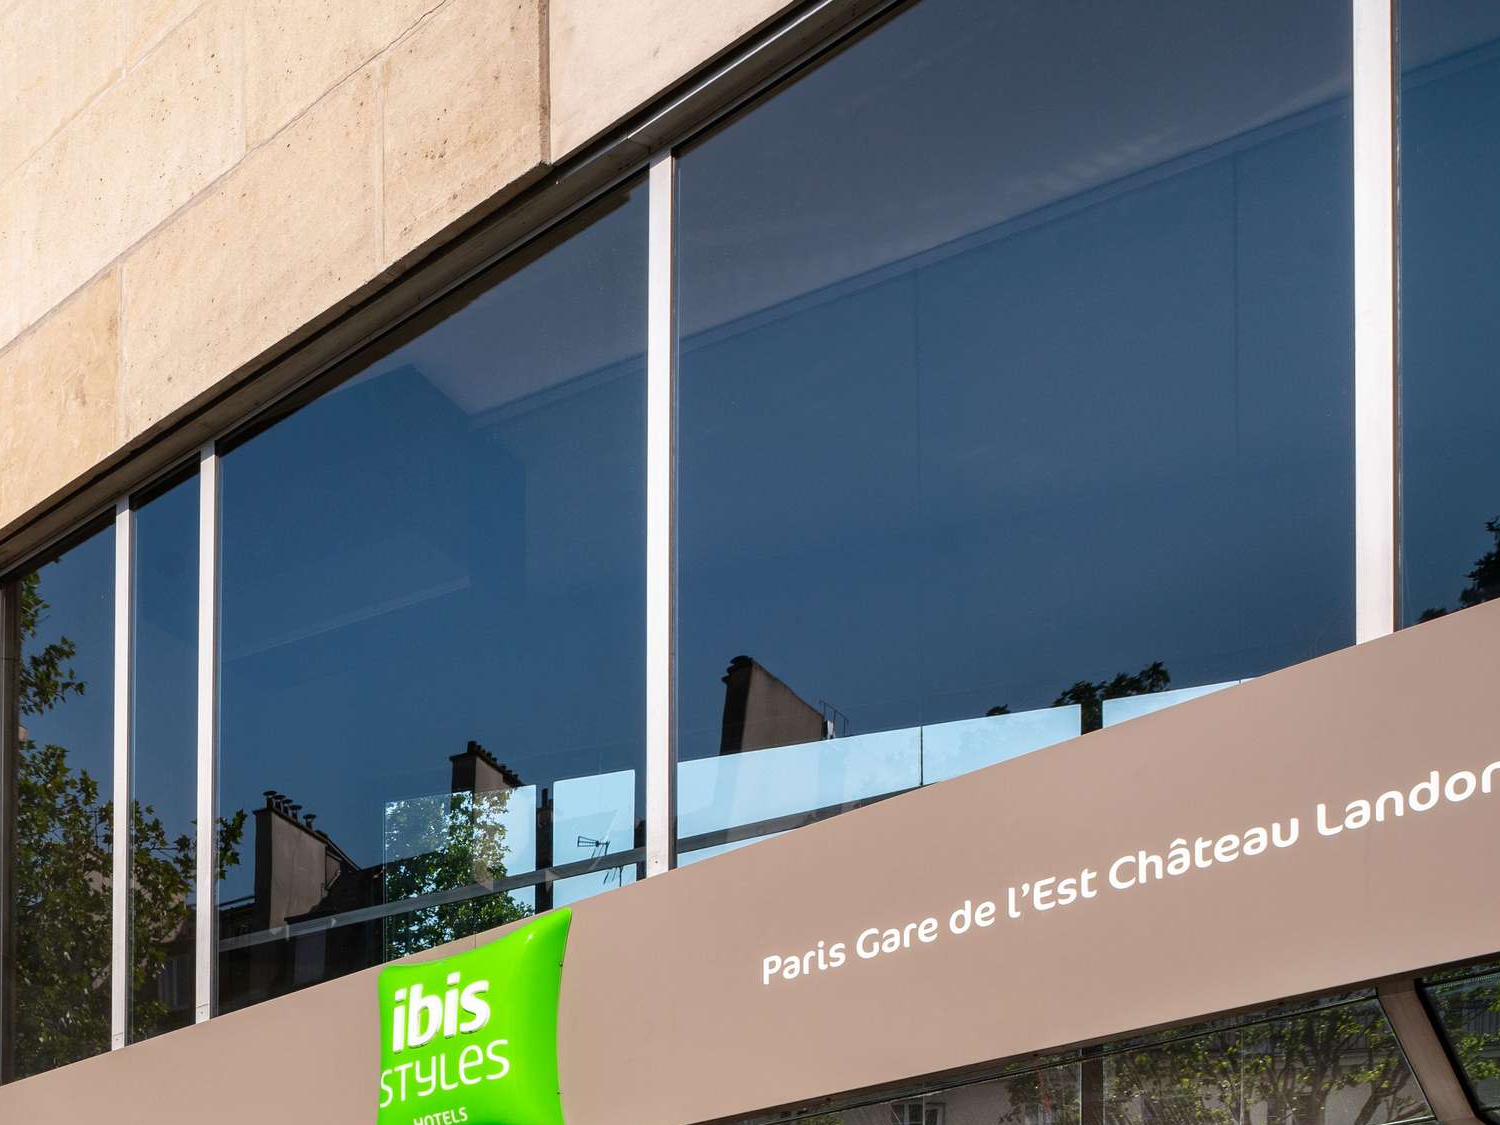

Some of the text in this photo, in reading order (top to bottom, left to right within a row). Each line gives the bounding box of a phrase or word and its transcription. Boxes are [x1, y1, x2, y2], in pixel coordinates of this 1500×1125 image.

[762, 939, 847, 985] Paris
[856, 917, 939, 959] Gare
[949, 899, 997, 934] de
[1107, 816, 1300, 890] Château
[392, 971, 492, 1054] ibis
